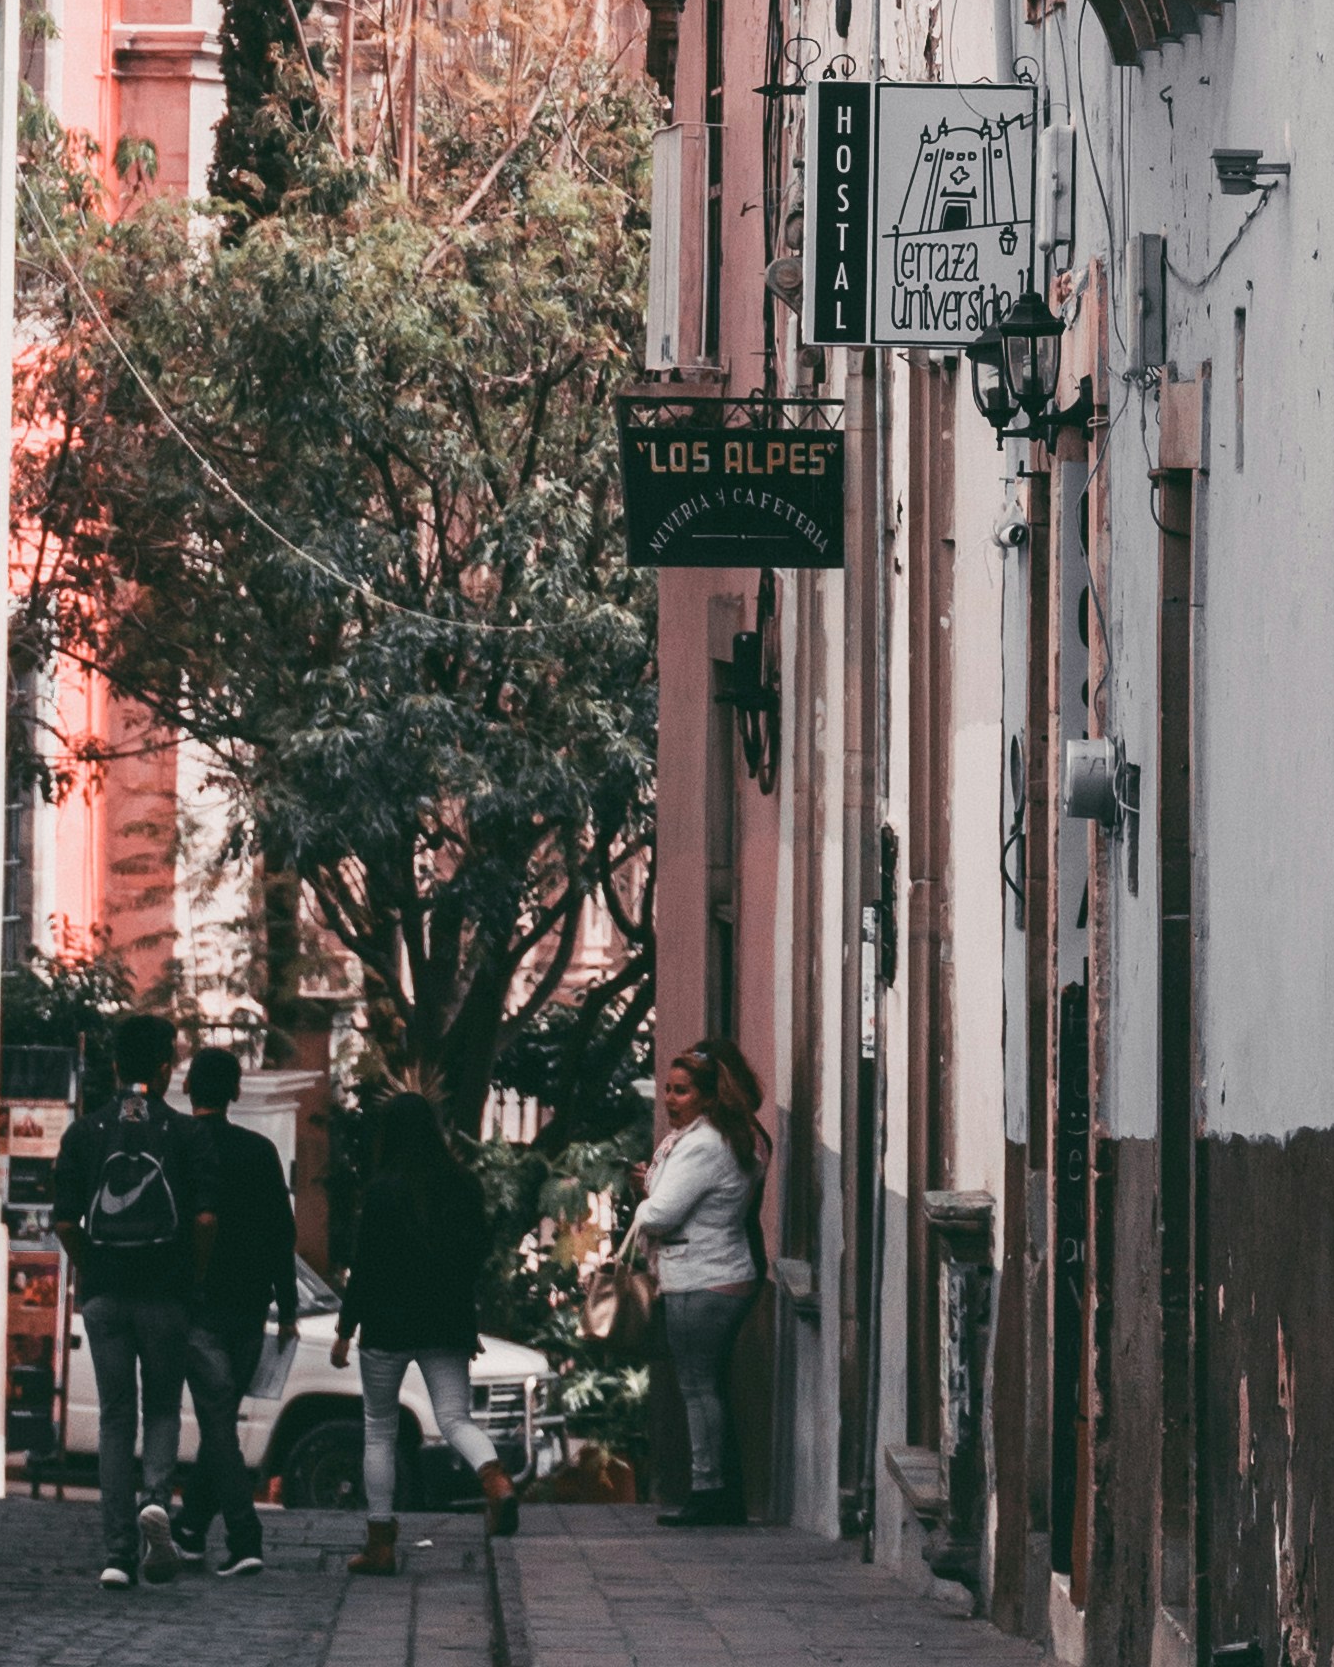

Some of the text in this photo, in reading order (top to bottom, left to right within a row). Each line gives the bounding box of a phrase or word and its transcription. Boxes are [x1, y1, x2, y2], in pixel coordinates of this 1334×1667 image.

[833, 105, 852, 329] HOSTAL
[648, 493, 711, 555] NEVERIA
[732, 487, 829, 555] CAFETERIA
